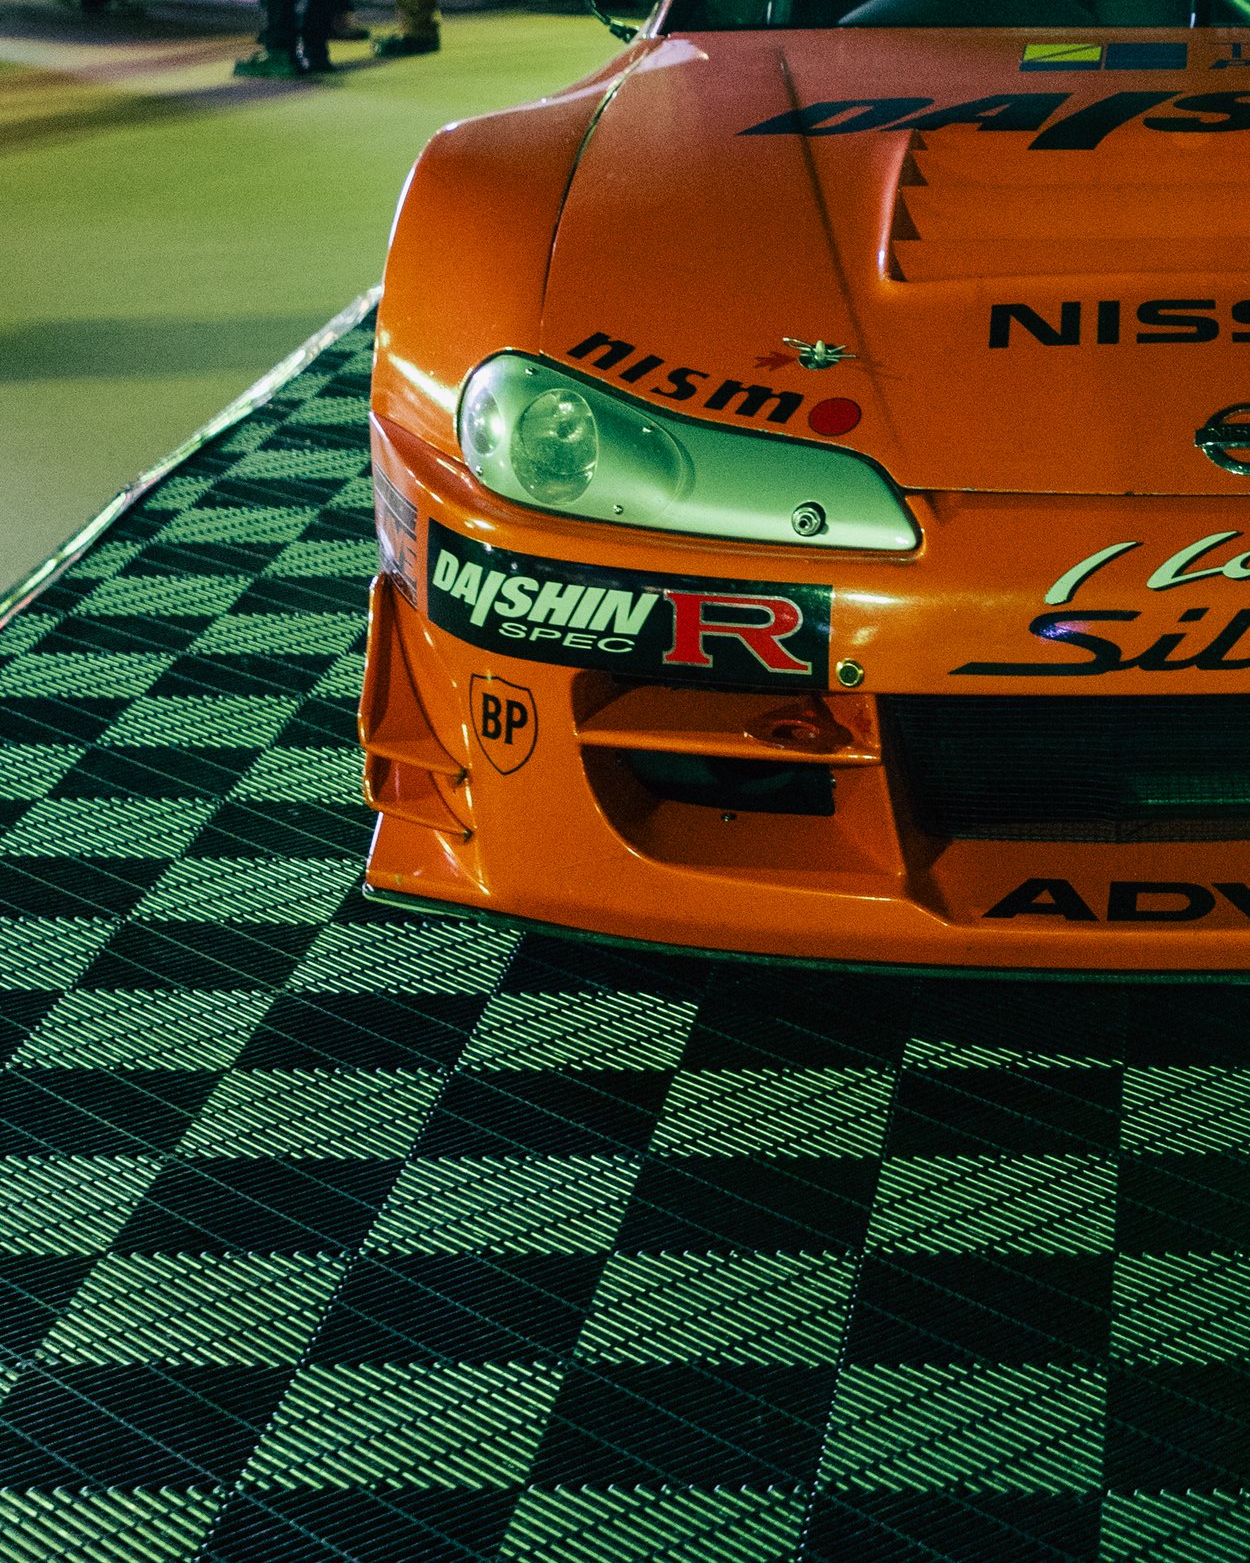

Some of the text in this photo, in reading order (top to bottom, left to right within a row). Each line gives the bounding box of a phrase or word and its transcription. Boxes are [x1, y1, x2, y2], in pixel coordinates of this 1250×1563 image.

[431, 550, 659, 628] DAISHIN
[1044, 541, 1140, 605] I
[497, 591, 813, 674] SPEC R
[481, 693, 528, 745] BP
